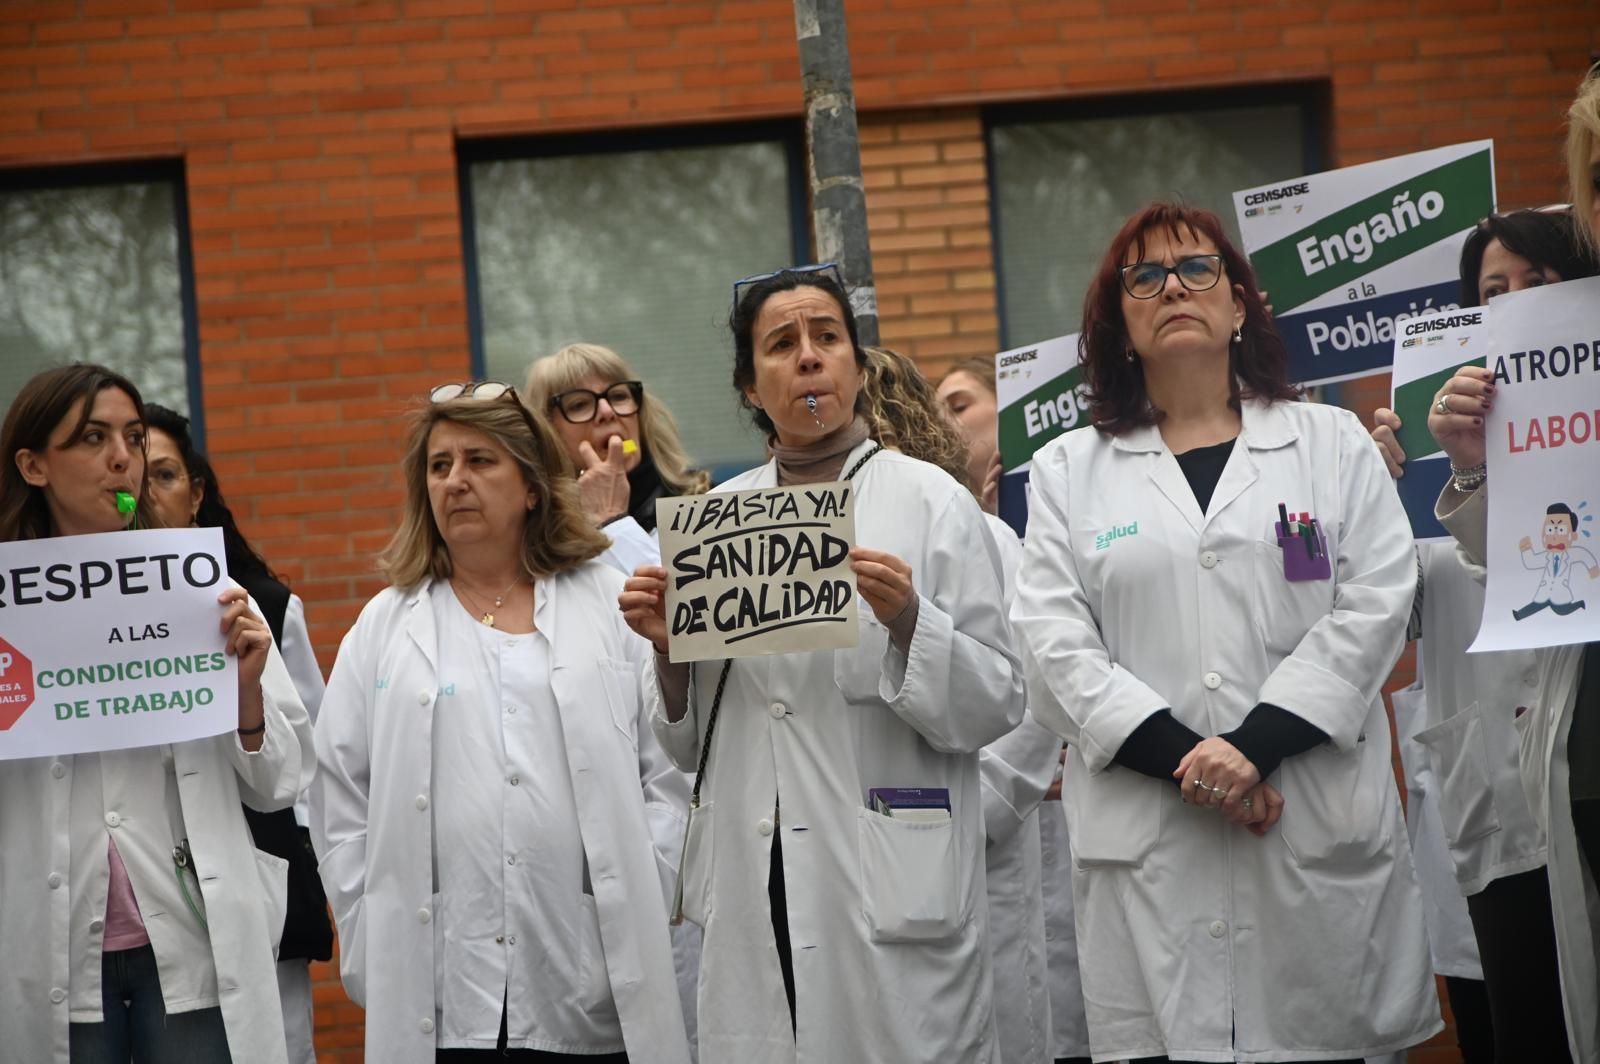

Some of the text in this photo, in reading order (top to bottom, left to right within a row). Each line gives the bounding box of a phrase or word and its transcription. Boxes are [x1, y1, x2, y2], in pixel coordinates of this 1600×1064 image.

[1244, 182, 1310, 206] CEMSATSE
[1296, 190, 1445, 277] Engaño
[1347, 281, 1377, 300] a la
[1405, 312, 1483, 336] CEMSATSE
[804, 488, 850, 518] YA!
[1096, 521, 1138, 545] salud
[0, 552, 221, 608] ESPETO
[671, 596, 709, 636] DE
[108, 623, 170, 644] A LAS
[37, 652, 226, 689] CONDICIONES
[54, 687, 214, 720] DE TRABAJO
